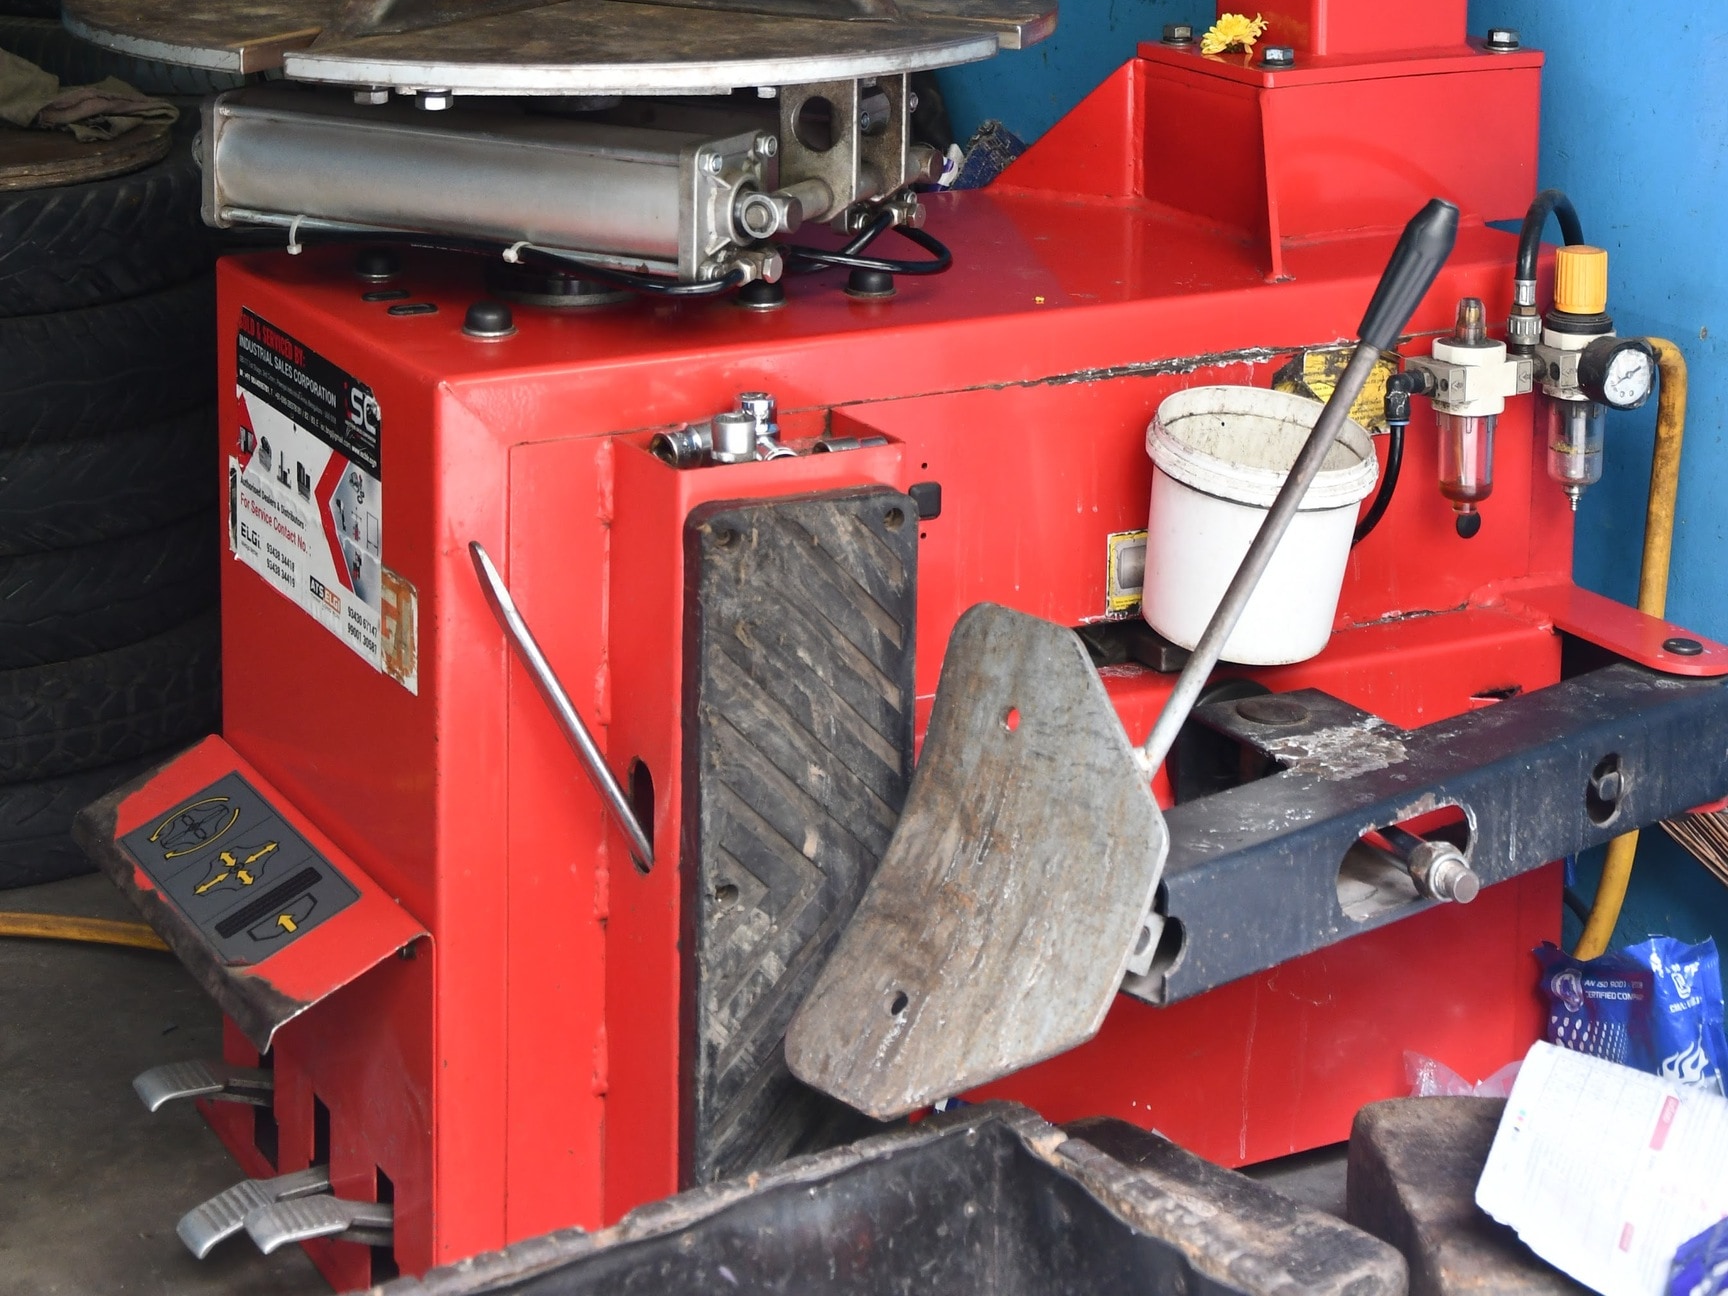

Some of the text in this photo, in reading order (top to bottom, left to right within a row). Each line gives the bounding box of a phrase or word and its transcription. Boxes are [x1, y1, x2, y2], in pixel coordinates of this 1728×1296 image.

[263, 325, 293, 361] SERVICED
[239, 334, 273, 366] INDUSTRIAL
[274, 356, 292, 378] SALES
[294, 369, 337, 408] CORPORATION
[241, 492, 250, 509] For
[251, 500, 272, 526] Service
[274, 517, 296, 545] Contact
[262, 490, 276, 508] Dealers
[281, 504, 304, 529] Distributors
[311, 579, 324, 600] ATS
